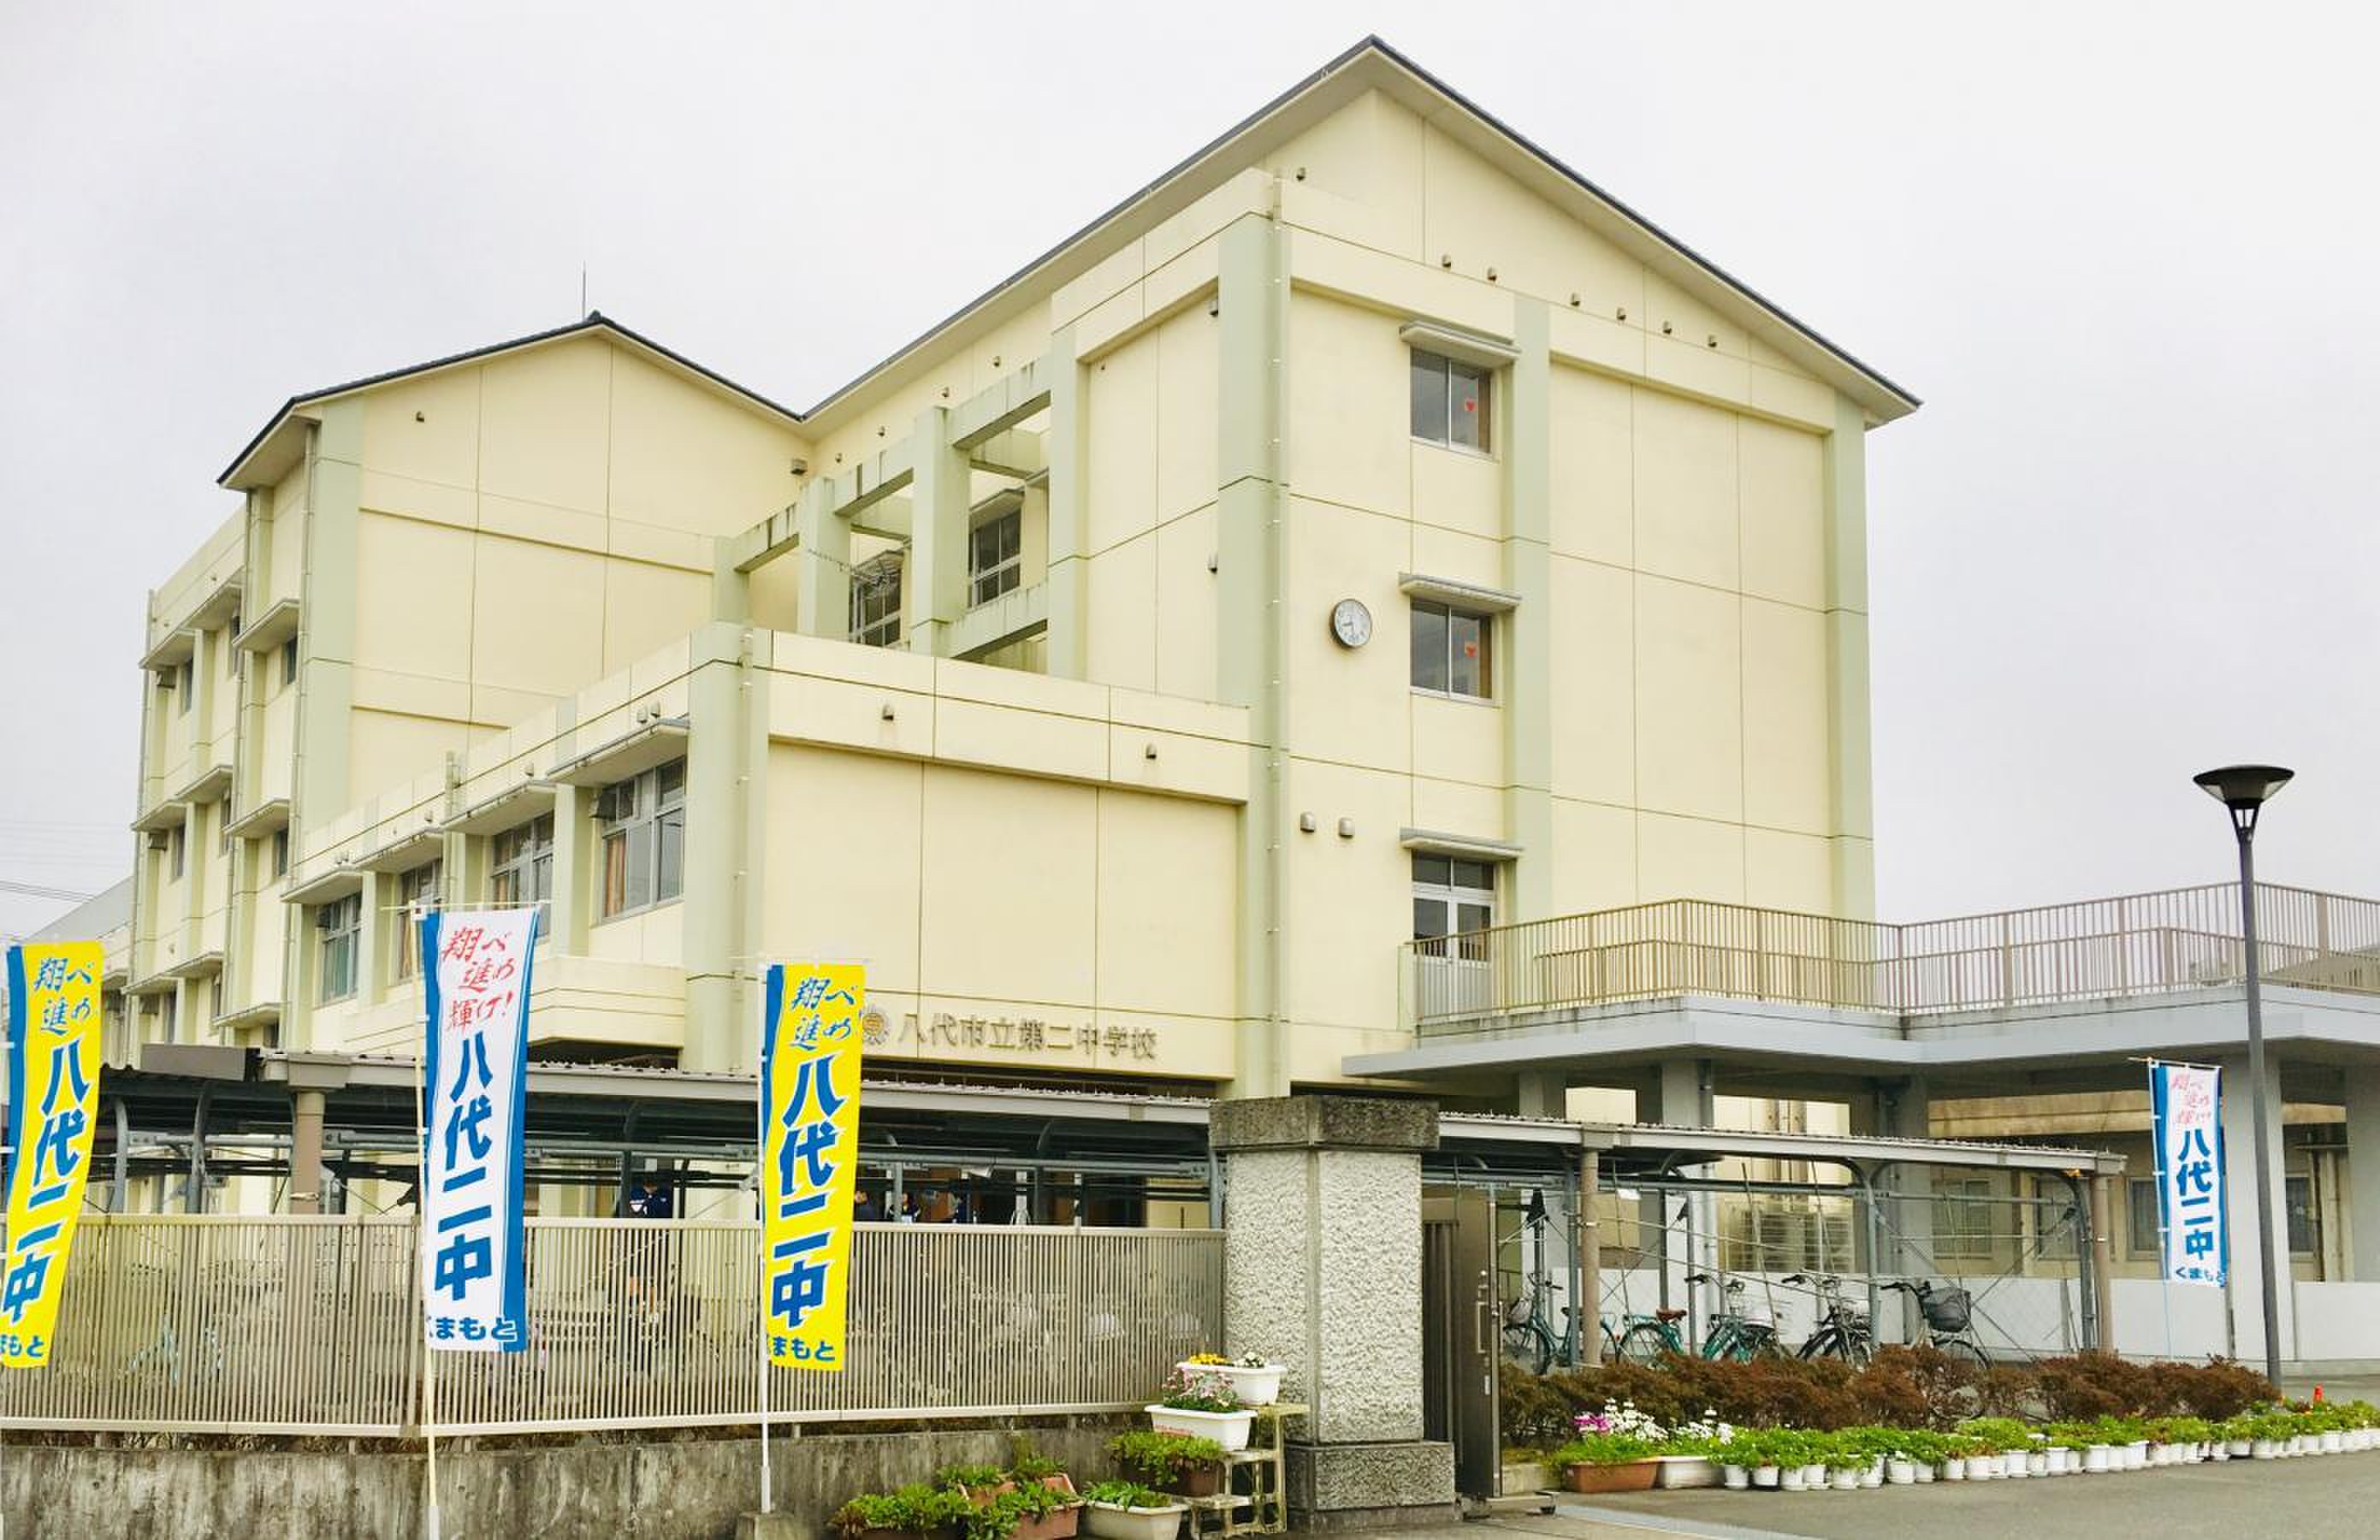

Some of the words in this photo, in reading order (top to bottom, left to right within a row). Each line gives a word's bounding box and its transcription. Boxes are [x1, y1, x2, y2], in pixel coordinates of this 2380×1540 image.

[441, 927, 512, 962] 翔べ
[458, 957, 515, 993] 進め
[40, 997, 91, 1036] 進め
[789, 1014, 850, 1051] 進め
[898, 1012, 1157, 1060] 八代市立第二中学校
[3, 1038, 90, 1323] 八代二中
[435, 1031, 494, 1300] 八代二中
[771, 1055, 846, 1328] 八代二中
[2176, 1128, 2213, 1260] 八代二中
[426, 1316, 518, 1342] まもと
[767, 1336, 835, 1361] まもと
